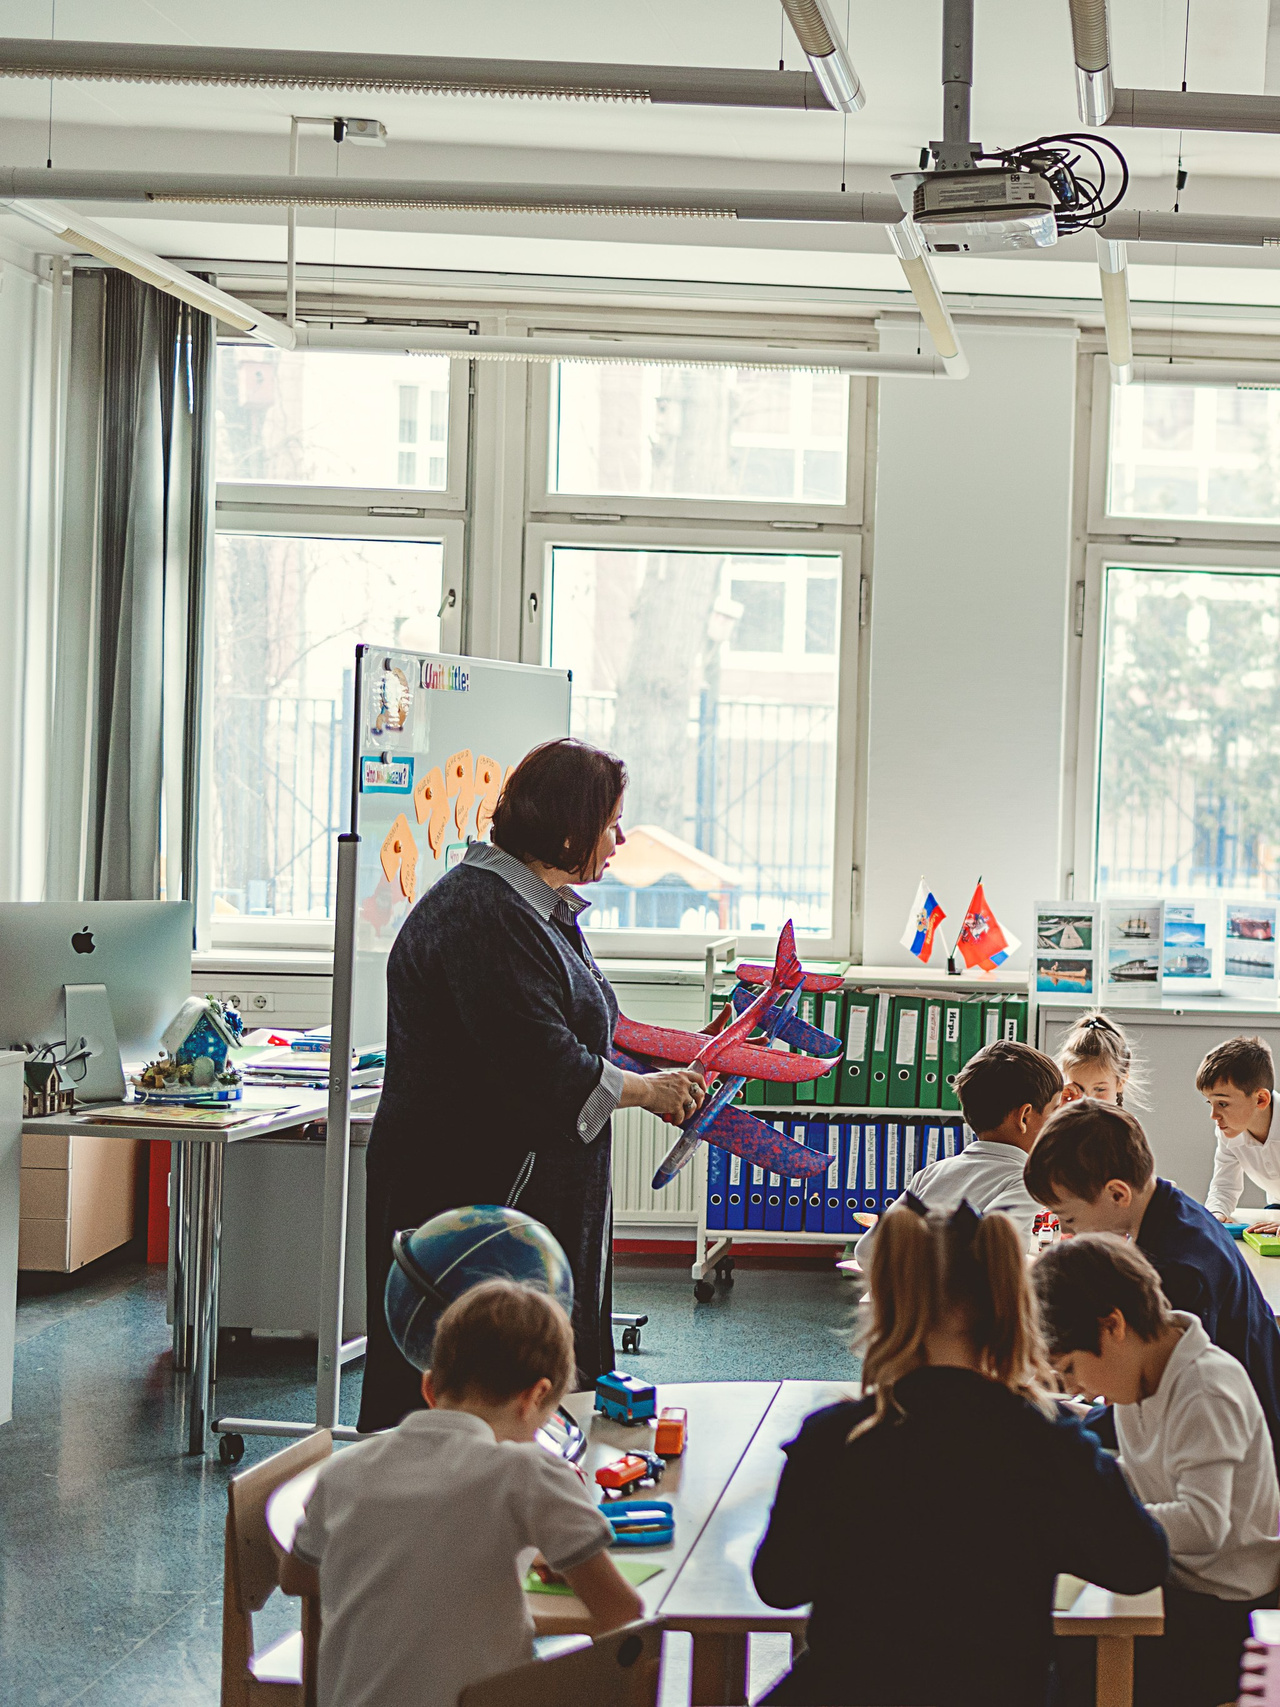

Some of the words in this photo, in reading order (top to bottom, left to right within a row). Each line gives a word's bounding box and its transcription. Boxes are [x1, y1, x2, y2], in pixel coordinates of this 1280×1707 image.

[425, 663, 445, 690] Unit
[448, 665, 469, 691] title:
[948, 1011, 957, 1039] Игры
[867, 1128, 876, 1153] Роберт
